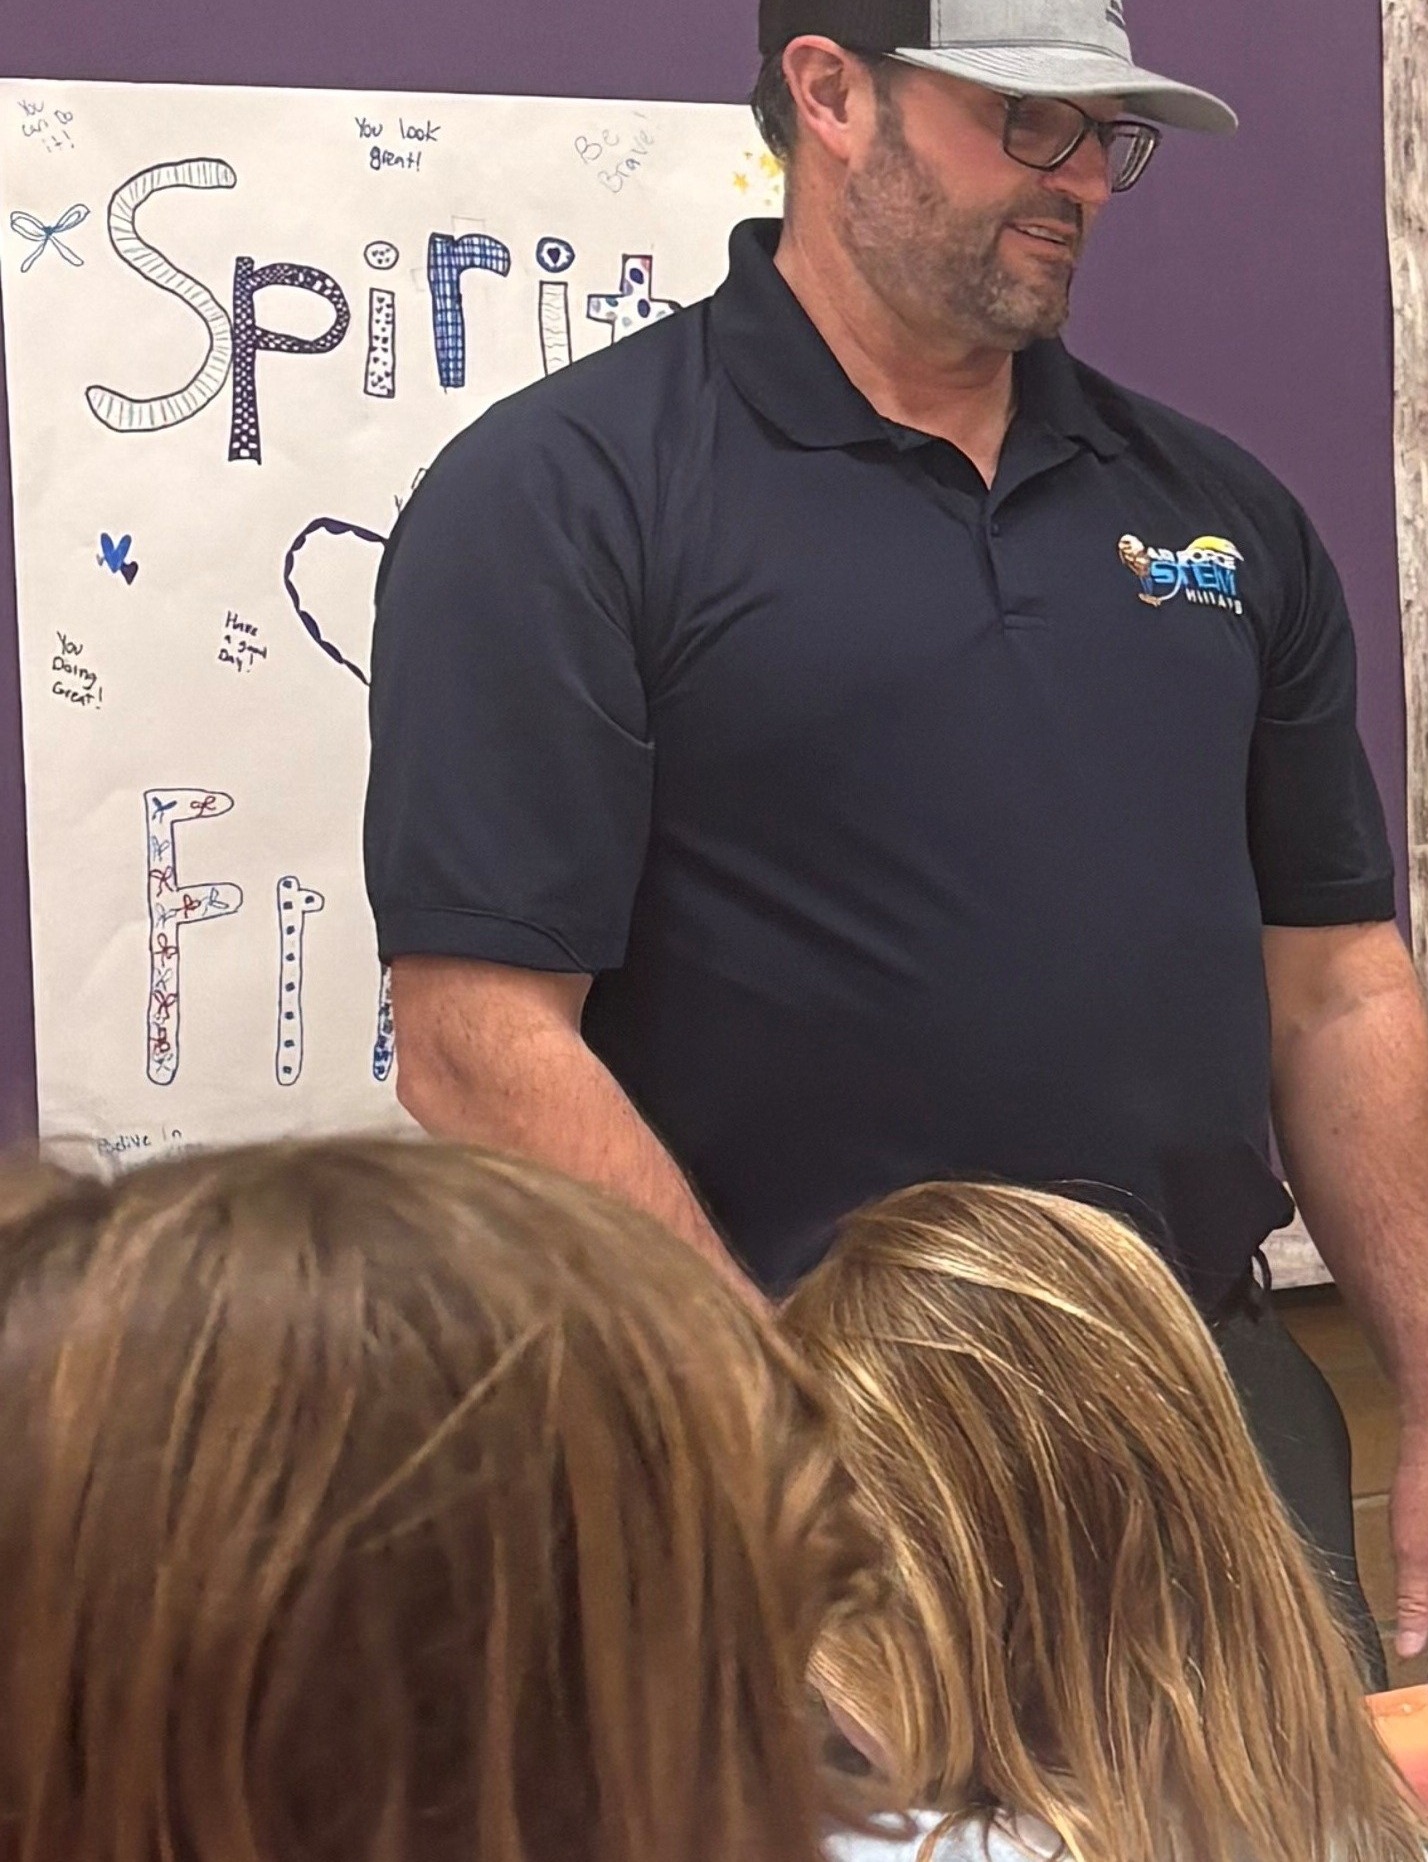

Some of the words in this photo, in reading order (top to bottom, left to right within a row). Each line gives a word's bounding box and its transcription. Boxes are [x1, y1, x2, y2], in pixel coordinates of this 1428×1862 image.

[355, 117, 383, 138] You
[399, 117, 441, 142] look
[369, 146, 422, 172] great!
[574, 129, 619, 166] Be
[86, 157, 684, 465] Spirit
[1151, 561, 1236, 595] STEM
[225, 610, 258, 637] Have
[56, 630, 83, 655] You
[224, 634, 231, 644] a
[52, 656, 97, 690] Doing
[218, 649, 254, 673] Day!
